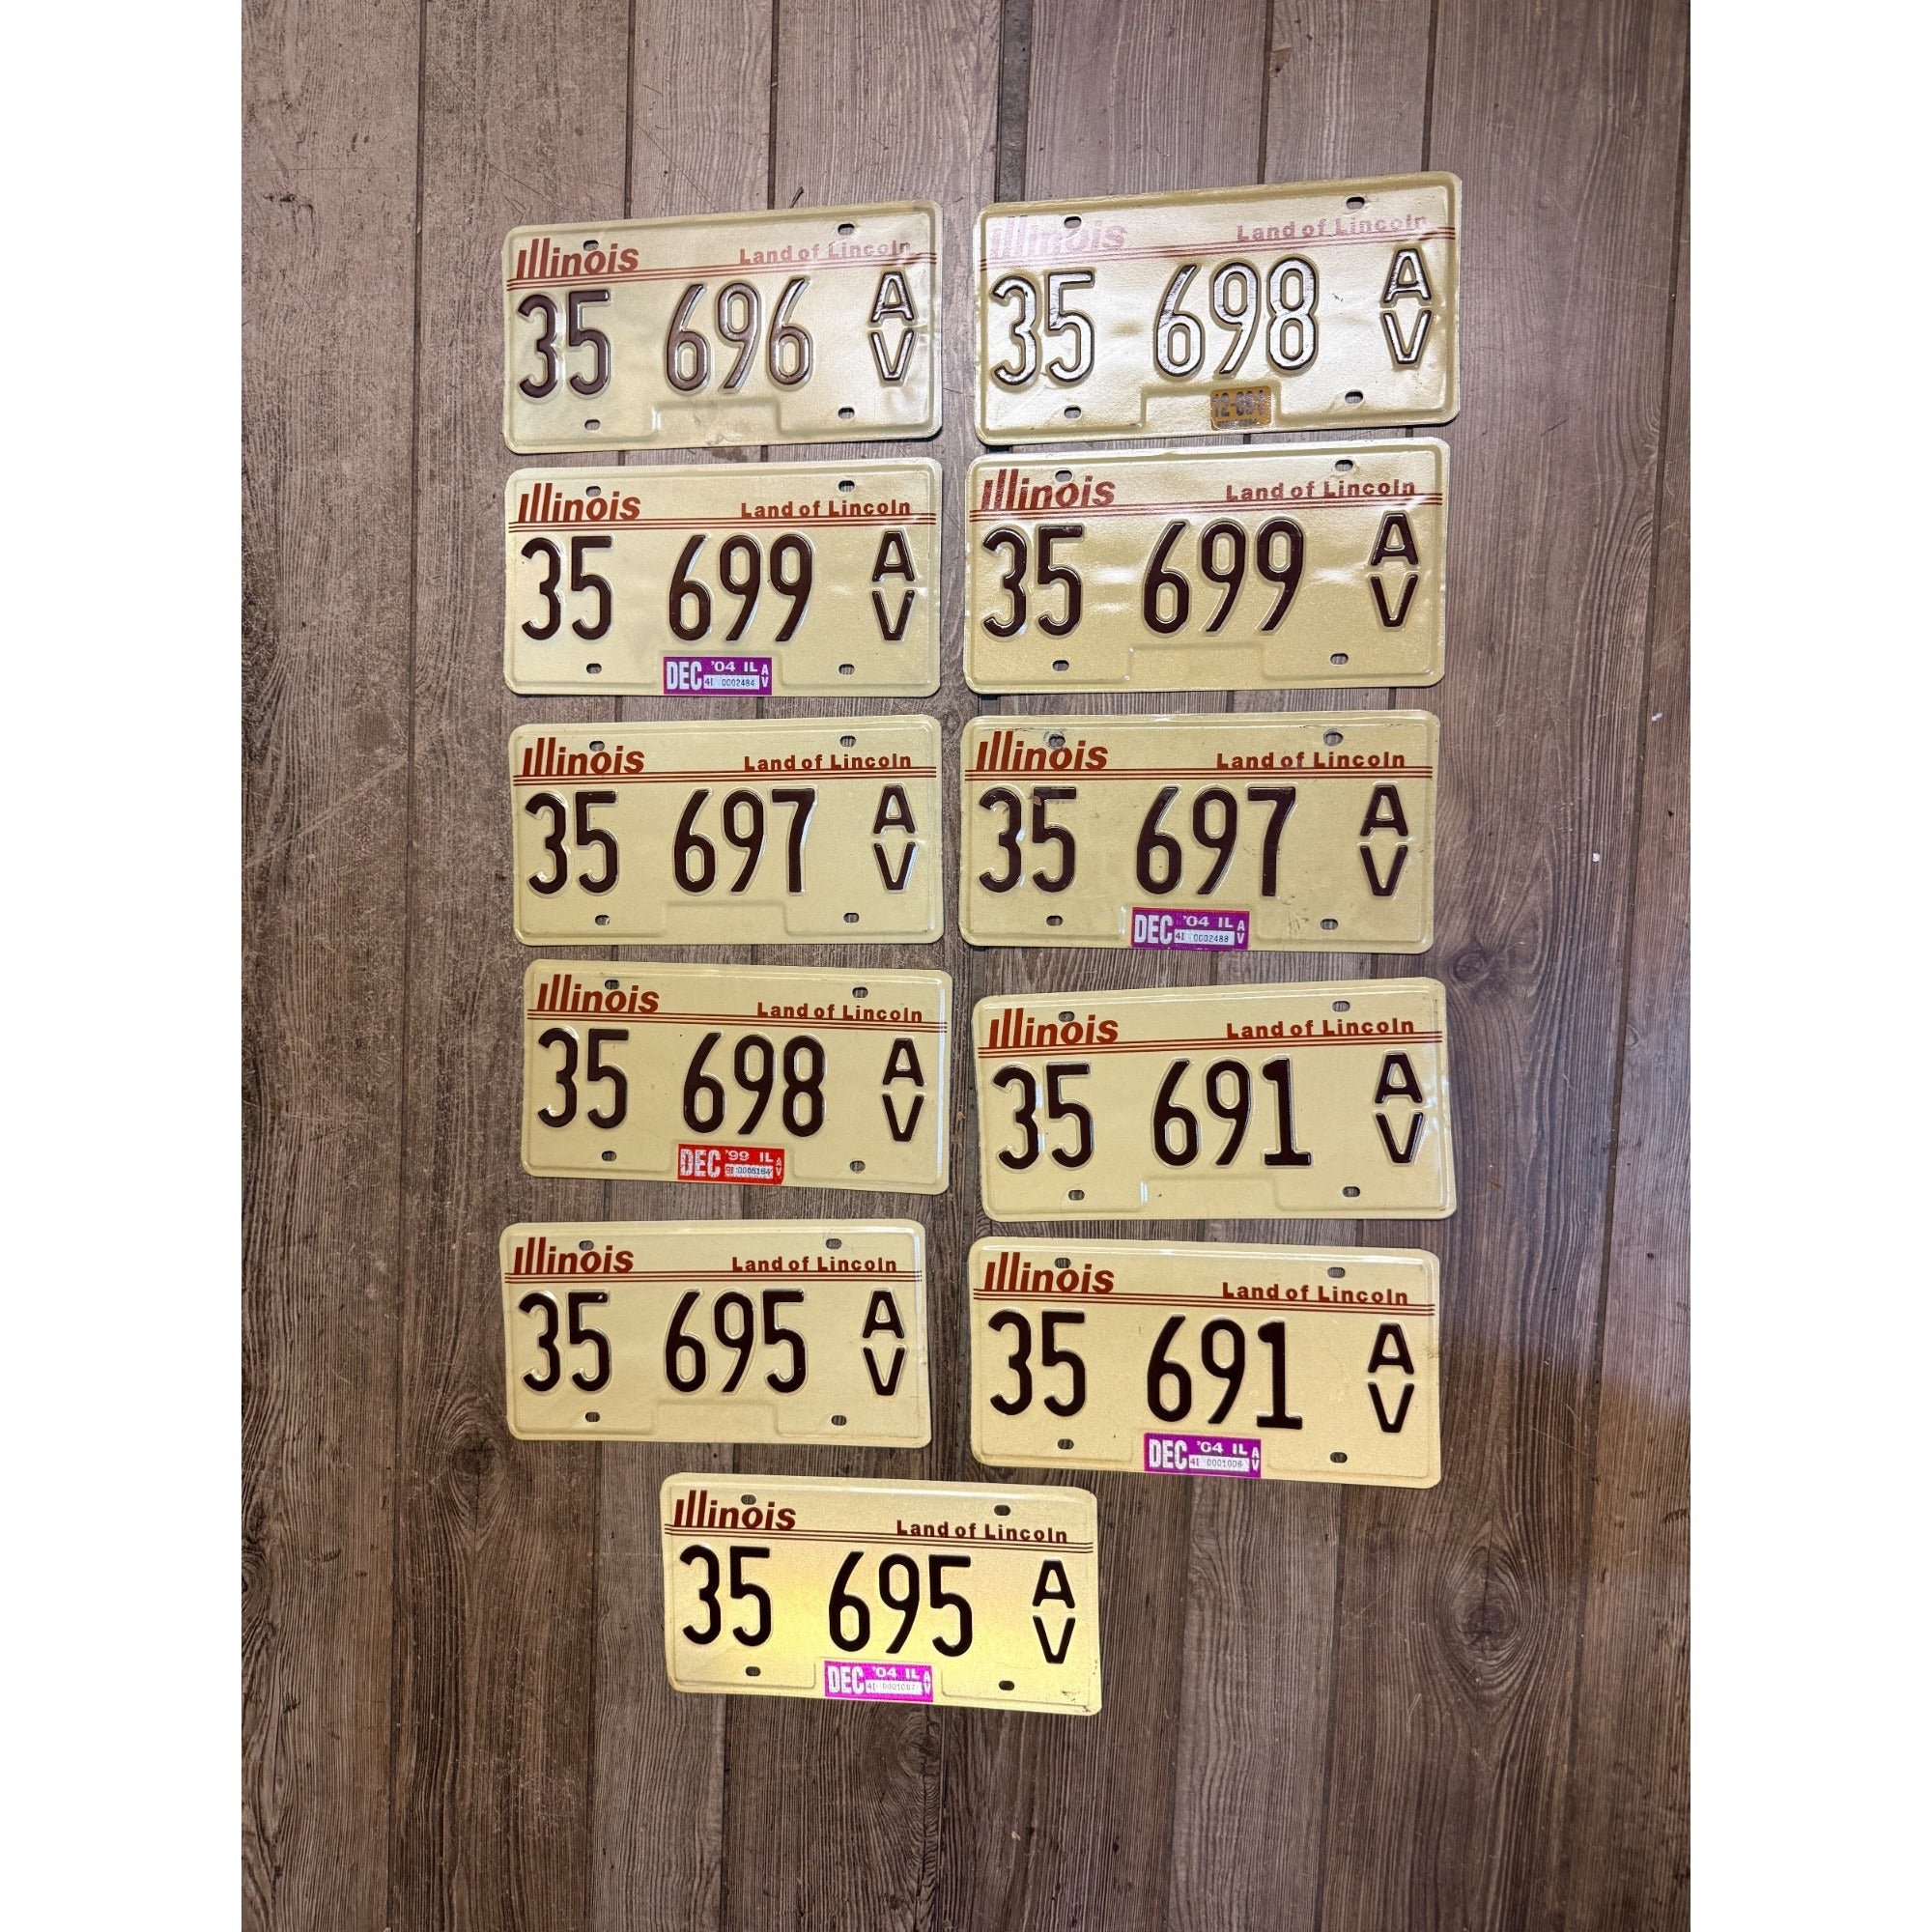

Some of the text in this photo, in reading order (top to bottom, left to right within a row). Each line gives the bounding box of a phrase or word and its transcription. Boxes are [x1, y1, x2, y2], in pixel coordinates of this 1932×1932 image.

[991, 215, 1126, 260] Illinois
[1237, 213, 1429, 242] Land of Lincoln
[516, 238, 639, 279] Illinois
[740, 241, 911, 265] Land of Lincoln
[518, 276, 810, 398] 35 696
[992, 258, 1318, 385] 35 698
[518, 483, 640, 522] Illinois
[981, 469, 1116, 510] Illinois
[1226, 479, 1415, 501] Land of Lincoln
[741, 499, 911, 519] Land of Lincoln
[522, 534, 812, 641] 35 699
[982, 521, 1304, 637] 35 699
[667, 661, 702, 690] DEC
[744, 662, 757, 672] IL
[523, 737, 645, 776] Illinois
[745, 753, 911, 771] Land of Lincoln
[977, 730, 1108, 770] Illinois
[1217, 751, 1405, 769] Land of Lincoln
[525, 788, 815, 895] 35 697
[979, 786, 1296, 896] 35 697
[1134, 915, 1174, 944] DEC
[1218, 917, 1234, 927] IL
[536, 974, 660, 1012] Illinois
[757, 1002, 923, 1023] Land of Lincoln
[988, 1008, 1119, 1048] Illinois
[1227, 1017, 1414, 1038] Land of Lincoln
[537, 1028, 825, 1137] 35 698
[992, 1057, 1312, 1168] 35 691
[680, 1149, 721, 1178] DEC
[759, 1151, 773, 1162] IL
[514, 1237, 634, 1275] Illinois
[732, 1256, 896, 1272] Land of Lincoln
[983, 1252, 1114, 1293] Illinois
[1223, 1282, 1407, 1305] Land of Lincoln
[519, 1291, 807, 1393] 35 695
[987, 1311, 1302, 1429] 35 691
[1150, 1439, 1187, 1469] DEC
[1233, 1443, 1248, 1455] IL
[675, 1490, 796, 1530] Illinois
[897, 1520, 1067, 1543] Land of Lincoln
[680, 1546, 973, 1657] 35 695
[828, 1665, 864, 1694] DEC
[905, 1668, 920, 1679] IL
